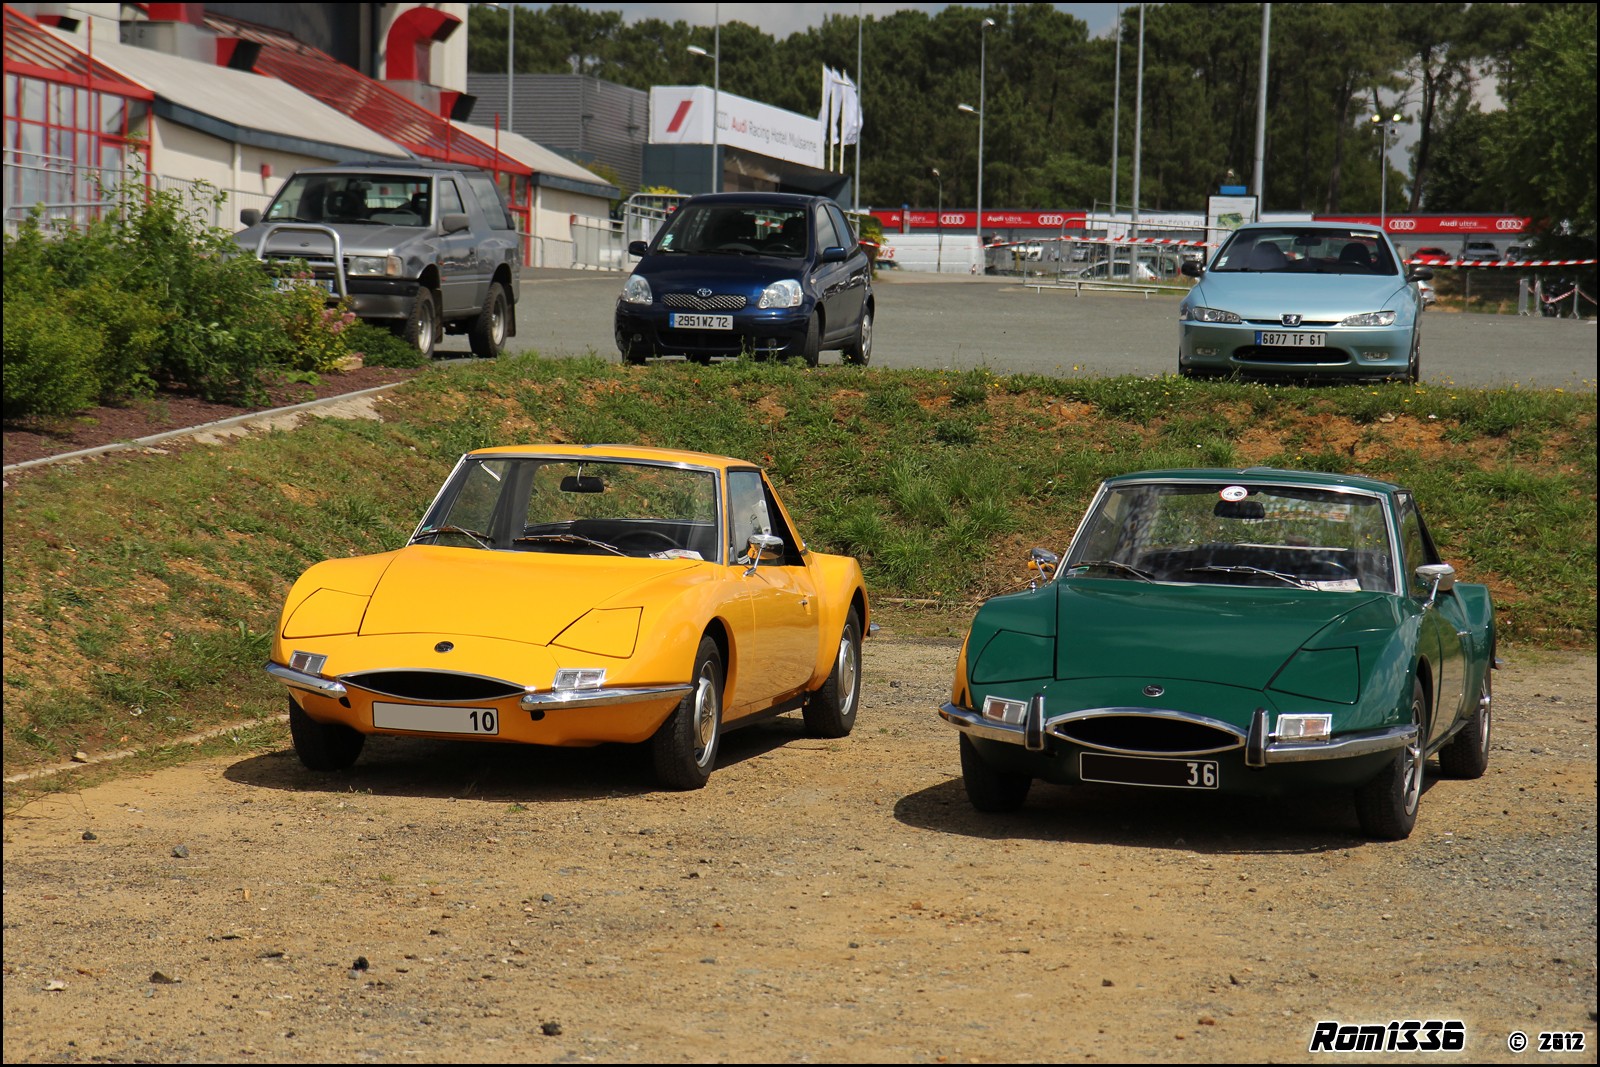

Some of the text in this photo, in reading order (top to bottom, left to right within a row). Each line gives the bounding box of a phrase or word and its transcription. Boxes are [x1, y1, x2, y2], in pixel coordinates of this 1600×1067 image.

[731, 117, 817, 153] Audi Racing Hotel Mulsanne
[678, 315, 728, 328] 2951 WZ 72
[1263, 333, 1321, 346] 6877 TF 61
[469, 711, 495, 732] 10
[1186, 762, 1215, 787] 36
